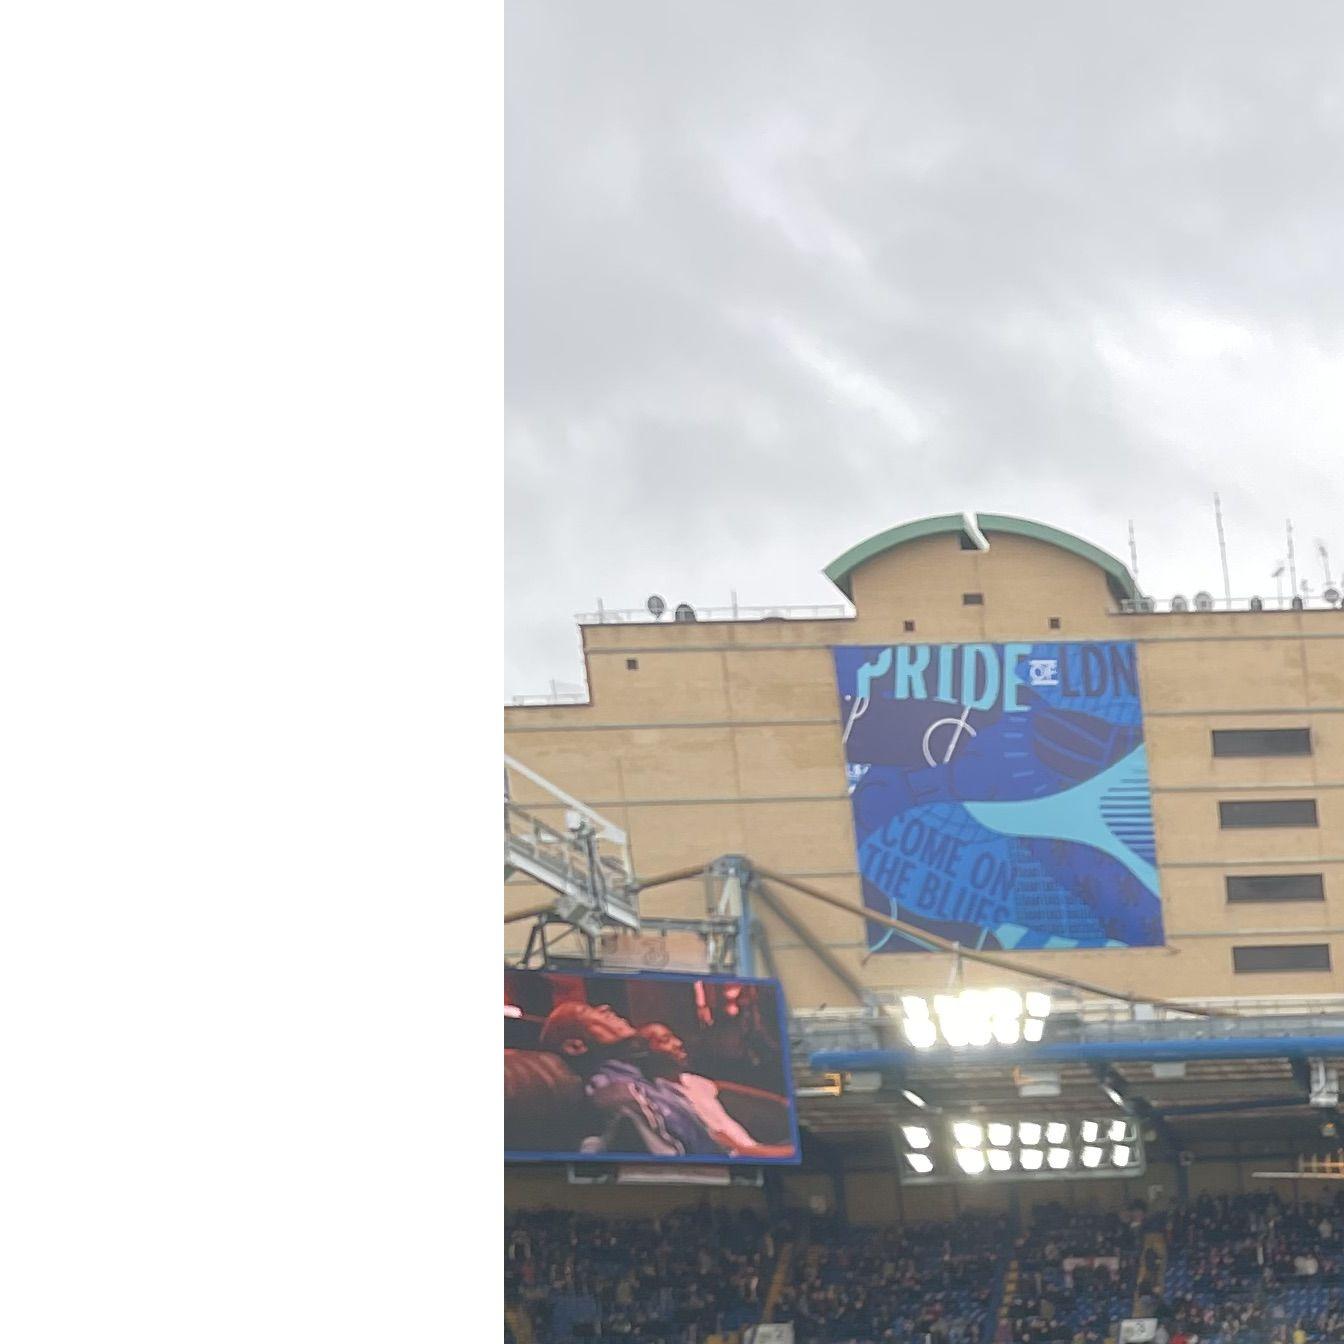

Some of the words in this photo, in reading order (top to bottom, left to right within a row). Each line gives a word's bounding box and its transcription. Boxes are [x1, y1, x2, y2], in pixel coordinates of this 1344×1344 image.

[857, 644, 1033, 712] PRIDE
[1060, 646, 1139, 698] LDN
[862, 842, 917, 900] THE
[880, 815, 968, 877] COME
[970, 851, 1018, 901] ON
